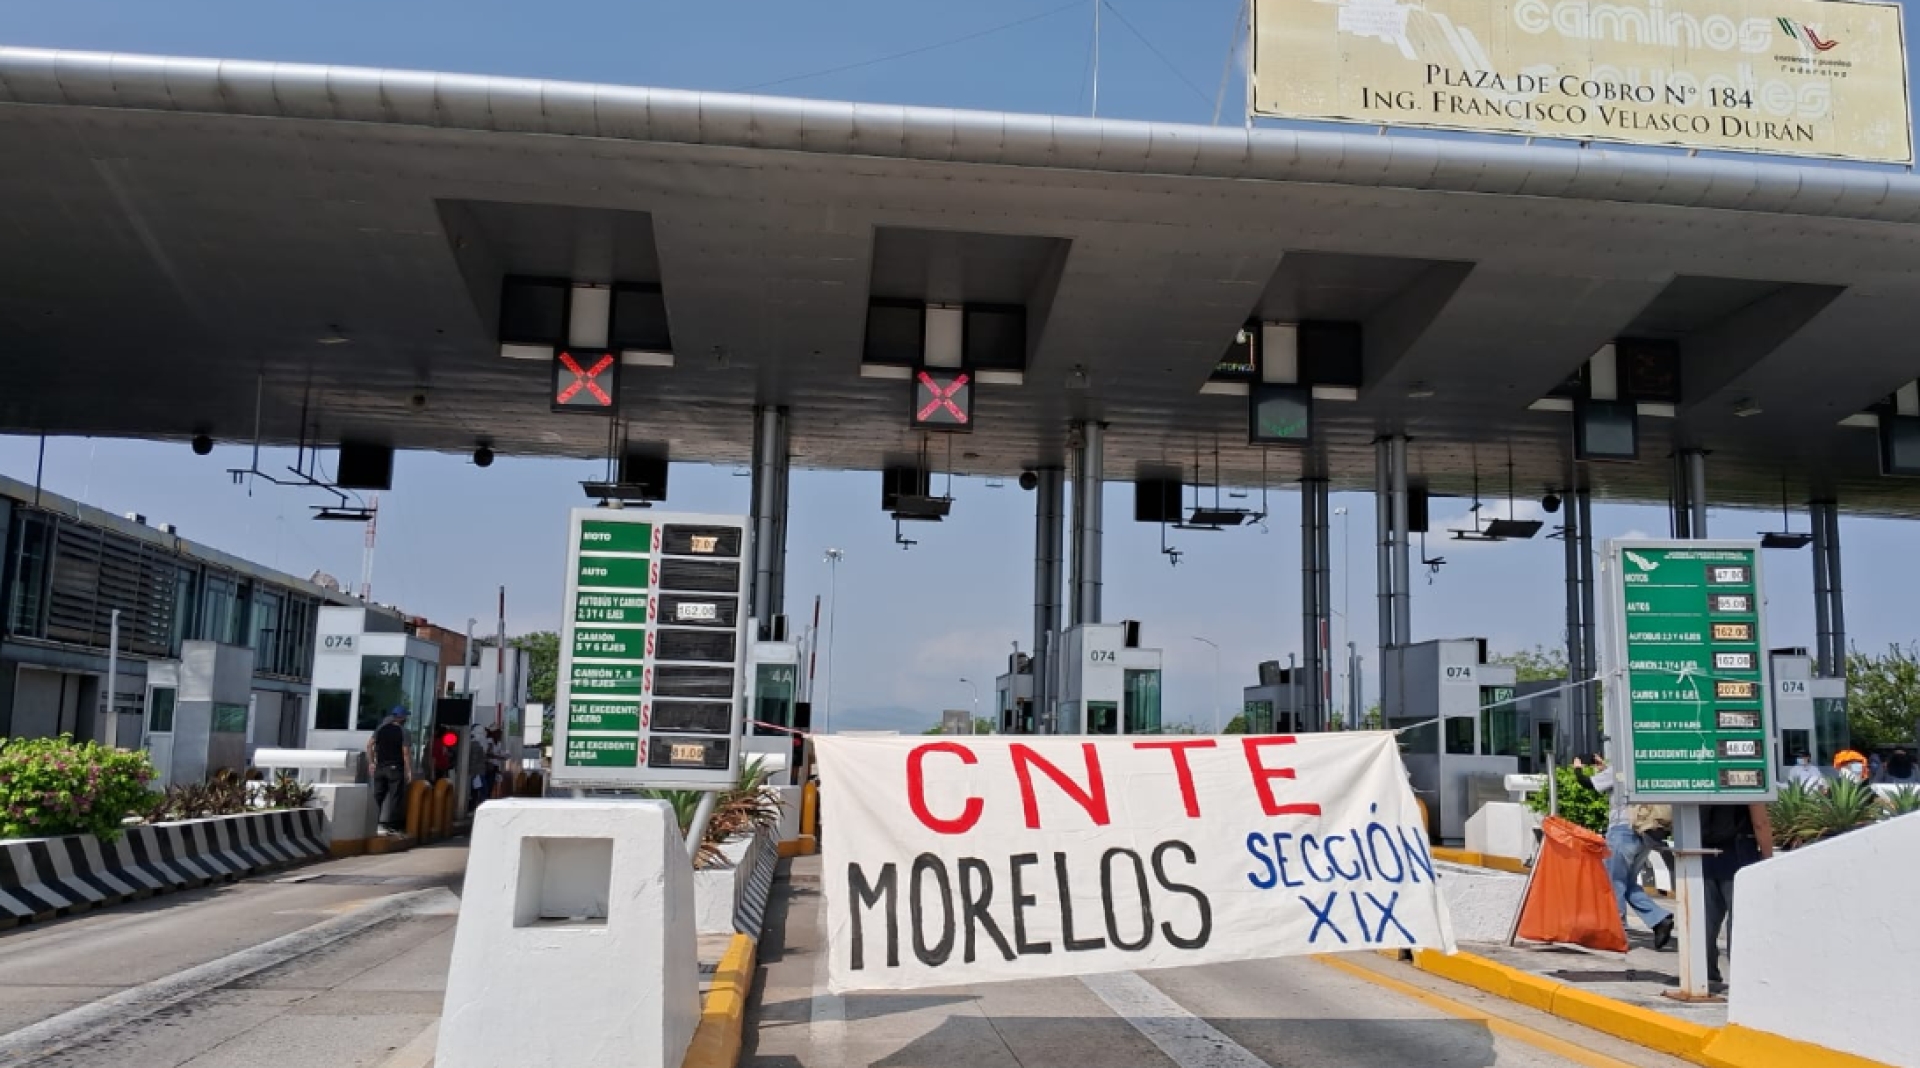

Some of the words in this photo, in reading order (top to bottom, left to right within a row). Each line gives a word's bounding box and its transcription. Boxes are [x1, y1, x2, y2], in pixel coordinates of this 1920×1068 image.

[1513, 0, 1772, 54] caminos
[1427, 64, 1506, 90] PLAZA
[1517, 74, 1550, 94] DE
[1559, 74, 1655, 103] COBRO
[1709, 87, 1754, 109] 184
[1362, 87, 1422, 110] ING.
[1433, 90, 1587, 125] FRANCISCO
[1599, 104, 1710, 134] VELASCO
[1721, 114, 1814, 142] DURÁN
[583, 531, 612, 542] MOTO
[652, 527, 660, 552] $
[581, 567, 608, 577] AUTO
[651, 563, 658, 585] $
[1625, 573, 1649, 583] MOTOS
[612, 596, 619, 607] Y
[649, 596, 656, 620] $
[1627, 601, 1650, 612] AUTOS
[606, 609, 624, 620] EJES
[324, 635, 353, 648] 074
[584, 642, 592, 651] Y
[602, 643, 626, 653] EJES
[646, 631, 655, 656] $
[1090, 649, 1116, 662] 074
[380, 661, 401, 677] 3A
[771, 668, 792, 683] 4A
[1446, 666, 1471, 678] 074
[644, 667, 651, 693] $
[1782, 681, 1805, 693] 074
[1826, 699, 1845, 712] 7A
[642, 704, 649, 728] $
[570, 740, 586, 749] EJE
[586, 740, 637, 751] EXCEDENTE
[640, 739, 648, 765] $
[569, 750, 598, 760] CARGA
[906, 735, 1322, 835] CNTE
[1691, 779, 1715, 789] CARGA
[1247, 803, 1437, 890] SECCIÓN
[848, 839, 1213, 971] MORELOS
[1299, 890, 1417, 944] XIX
